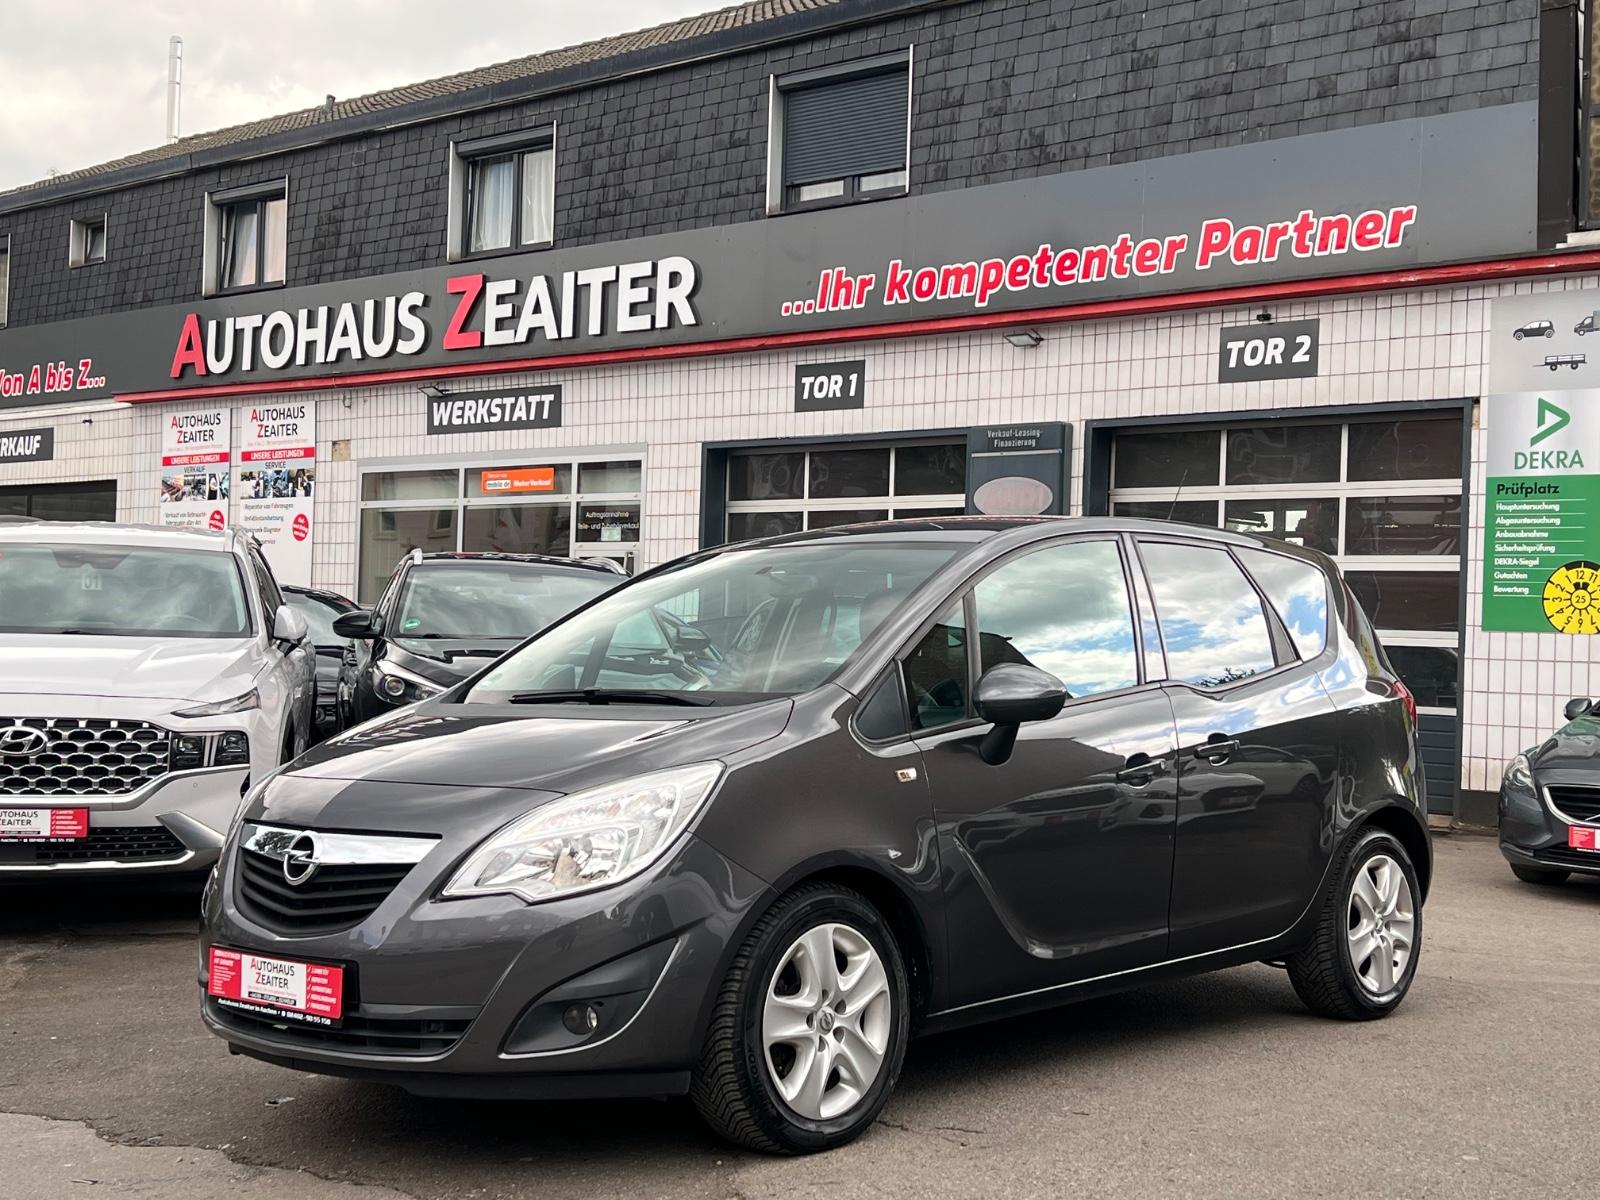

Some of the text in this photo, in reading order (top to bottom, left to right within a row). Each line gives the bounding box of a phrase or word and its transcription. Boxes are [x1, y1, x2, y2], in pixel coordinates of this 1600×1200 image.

[781, 205, 1417, 316] ...Ihr kompetenter Partner
[170, 256, 697, 378] AUTOHAUS ZEAITER
[1226, 334, 1312, 368] TOR 2
[27, 365, 40, 395] A
[45, 361, 74, 392] bis
[800, 372, 858, 400] TOR 1
[251, 406, 305, 423] AUTOHAUS
[432, 394, 555, 426] WERKSTATT
[171, 413, 221, 429] AUTOHAUS
[176, 429, 214, 444] ZEAITER
[257, 424, 298, 438] ZEAITER
[0, 435, 41, 457] RKAUF
[994, 439, 1036, 447] Finanzierung
[170, 454, 220, 465] UNSERE LEISTUNGEN
[251, 449, 304, 460] UNSERE LEISTUNGEN
[1514, 450, 1584, 470] DEKRA
[265, 461, 286, 470] SERVICE
[1496, 482, 1560, 498] Prüfplatz
[1496, 502, 1560, 512] Hauptuntersuchung
[1495, 516, 1561, 526] Abgasuntersuchung
[1495, 530, 1549, 538] Anbauabnahme
[1494, 543, 1556, 553] Sicherheitsprüfung
[1494, 557, 1540, 567] DEKRA-Siegel
[1494, 571, 1528, 580] Gutachten
[1575, 570, 1585, 580] 12
[1589, 572, 1598, 583] 11
[1493, 585, 1530, 594] Bewertung
[1555, 583, 1565, 592] 2
[1575, 595, 1586, 604] 25
[250, 957, 295, 977] AUTOHAUS
[255, 972, 289, 989] ZEAITER
